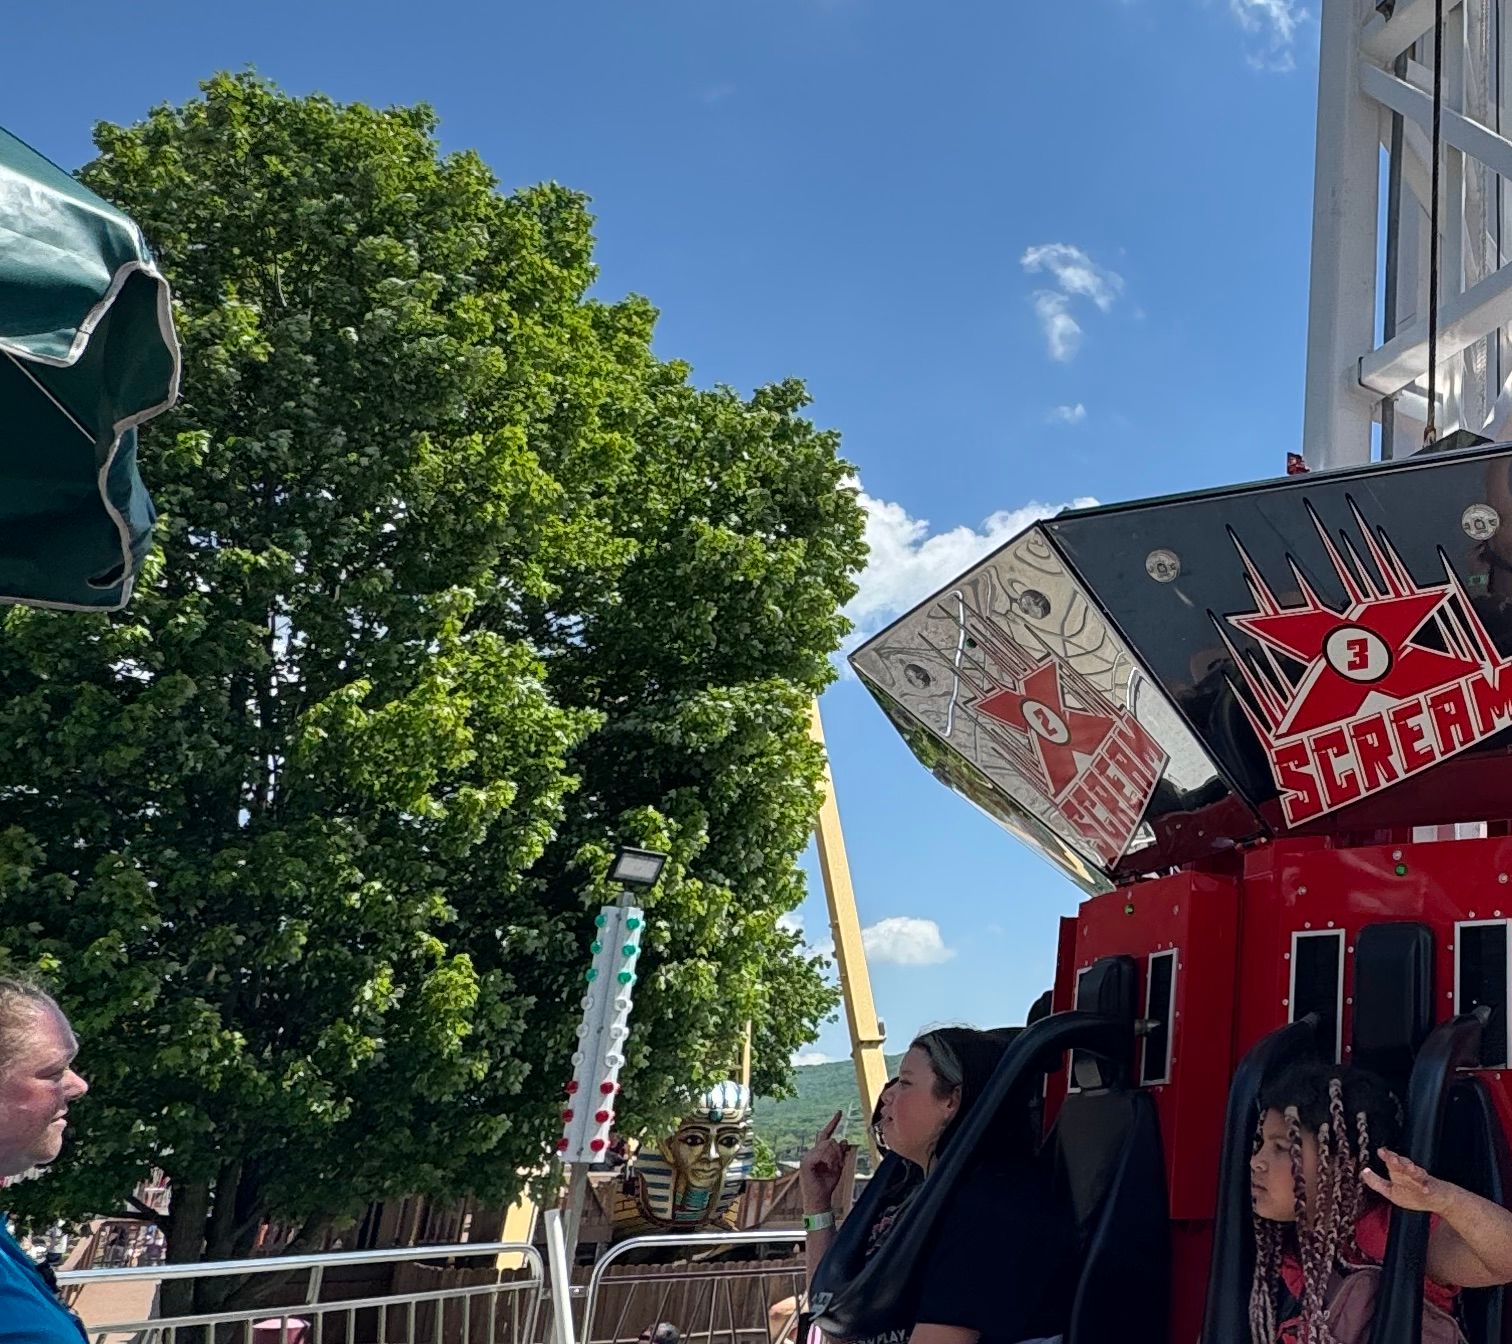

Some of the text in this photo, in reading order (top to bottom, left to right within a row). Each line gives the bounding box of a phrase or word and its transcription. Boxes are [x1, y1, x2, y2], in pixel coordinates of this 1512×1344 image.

[1346, 637, 1369, 672] 3
[1033, 707, 1058, 737] 2
[1059, 711, 1166, 867] SCREAM
